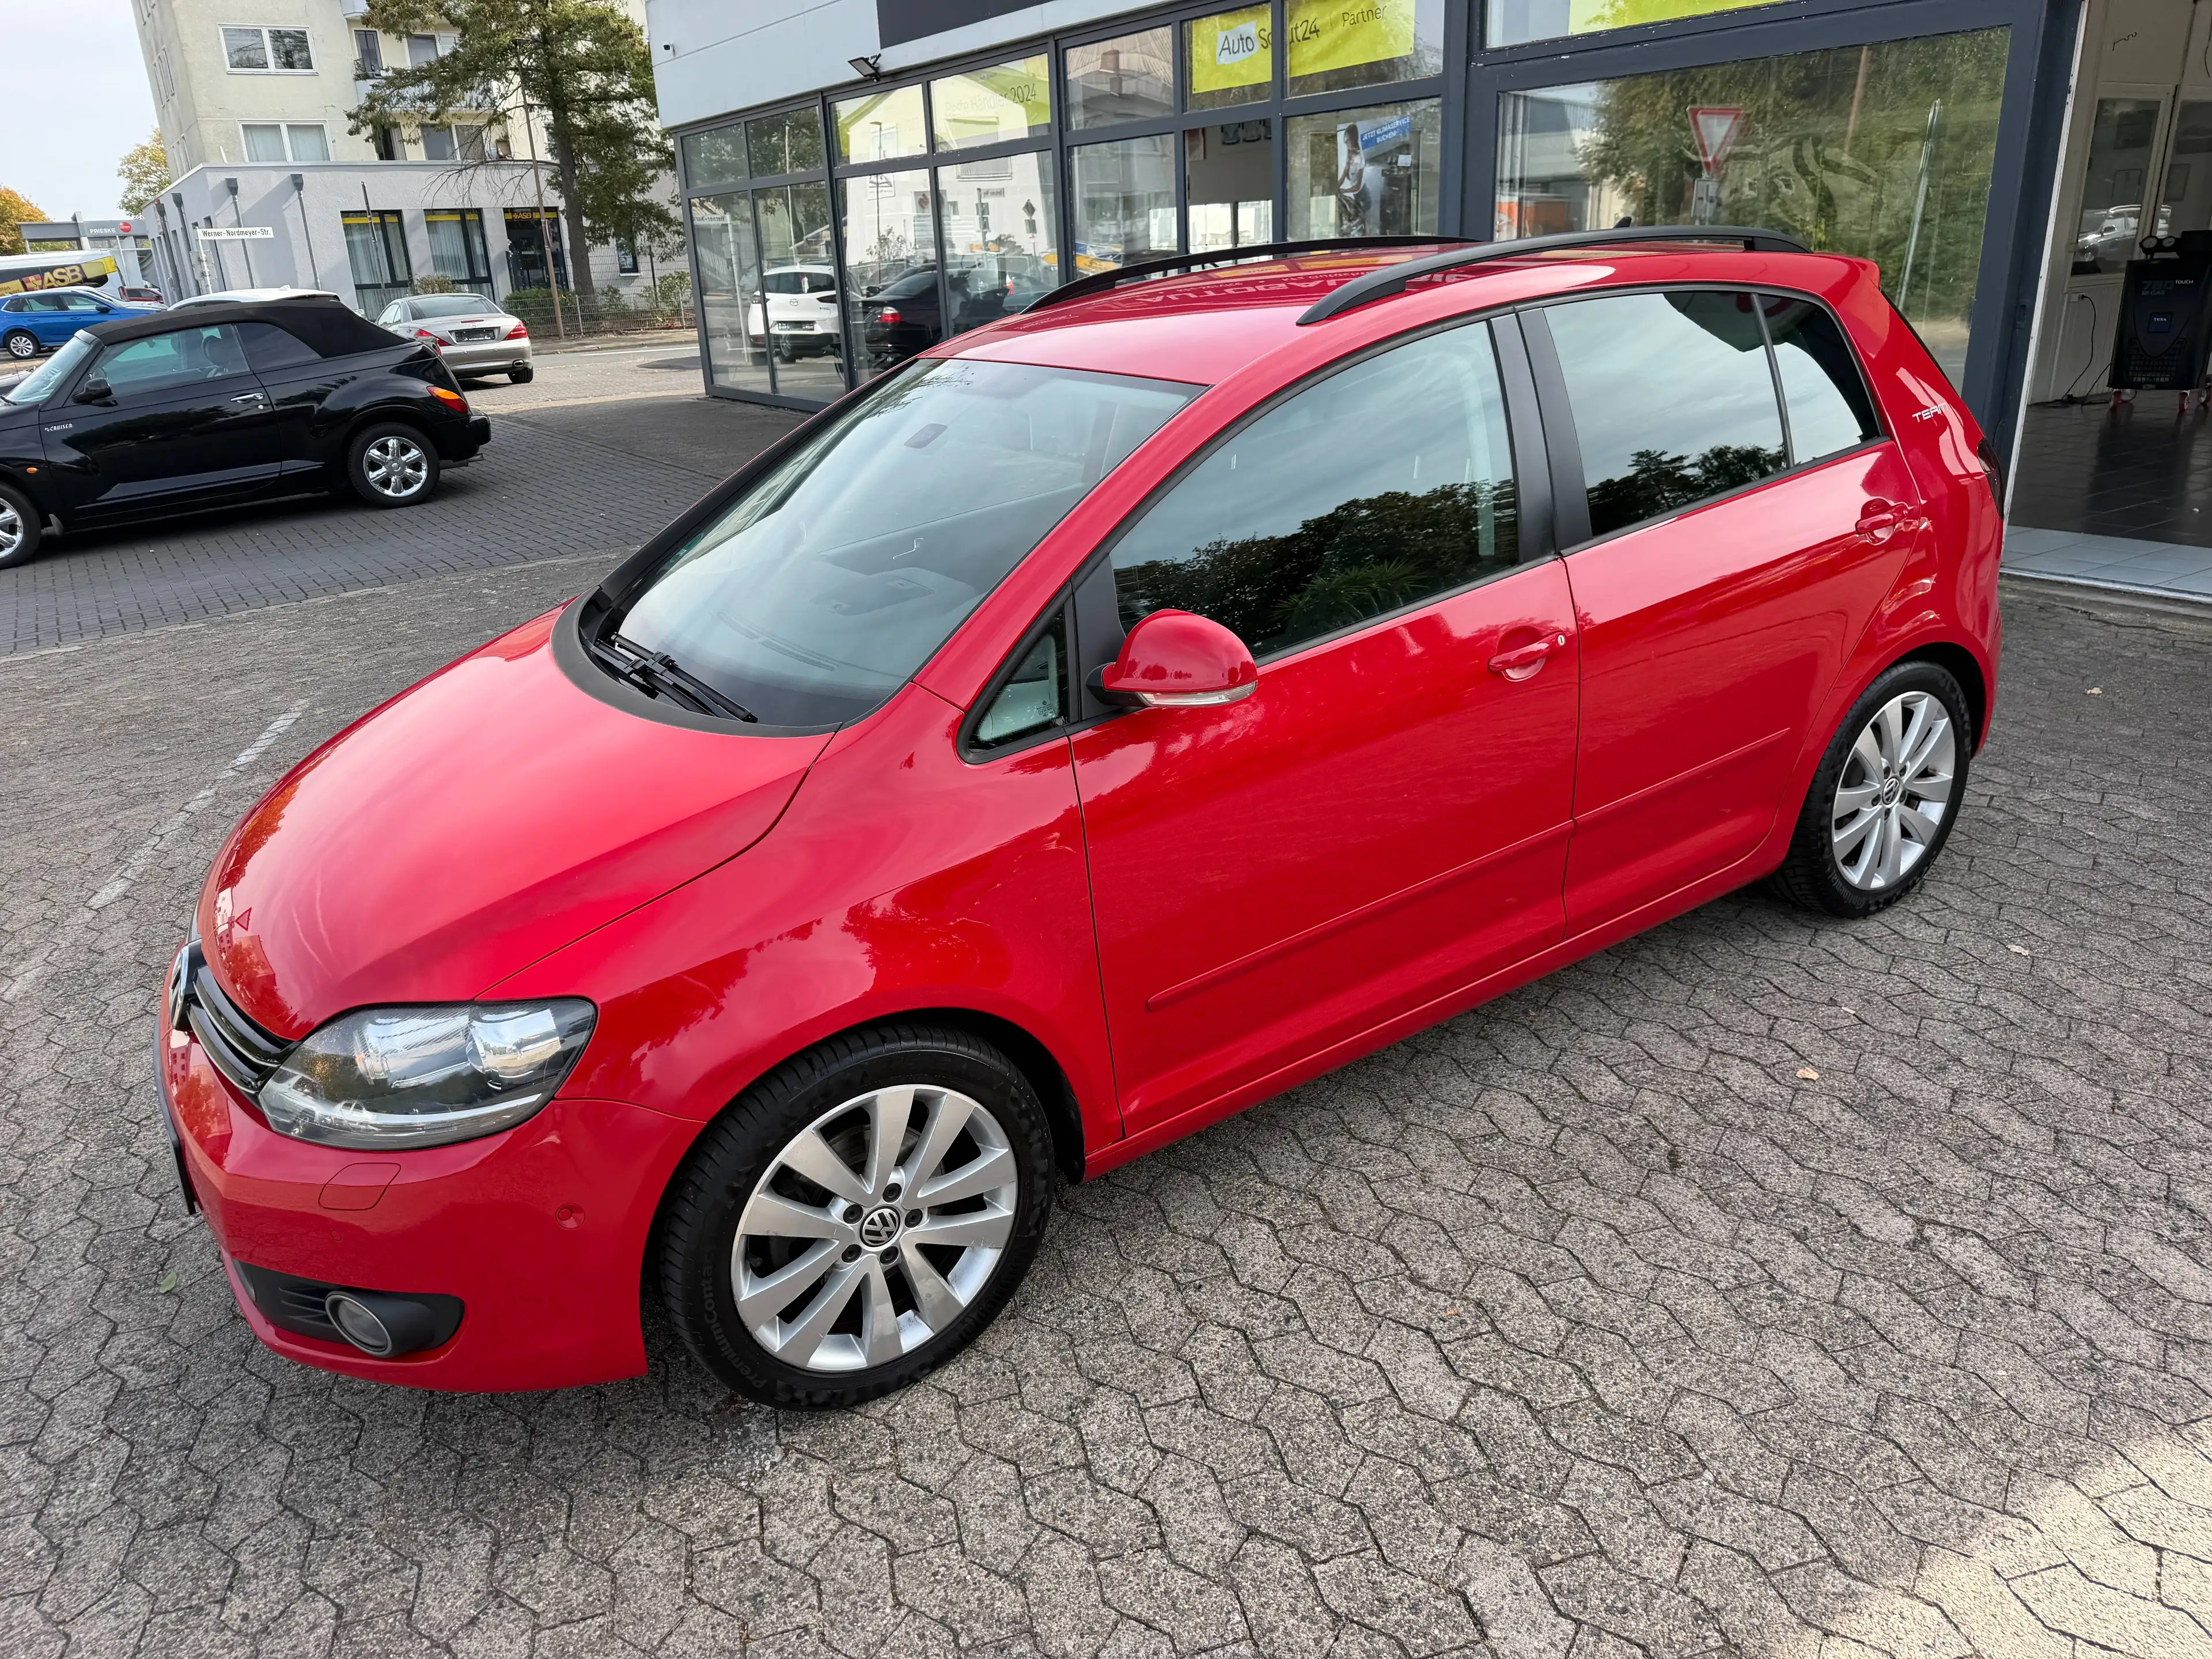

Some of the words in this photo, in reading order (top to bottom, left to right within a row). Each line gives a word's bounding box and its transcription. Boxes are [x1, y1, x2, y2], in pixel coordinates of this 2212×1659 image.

[1342, 5, 1387, 27] Partner
[1010, 83, 1037, 104] 2024
[202, 228, 271, 237] Werner-Nordmeyer-Str.
[43, 265, 83, 288] ASB
[1912, 402, 1948, 423] TEAM
[50, 423, 73, 431] CRUISER
